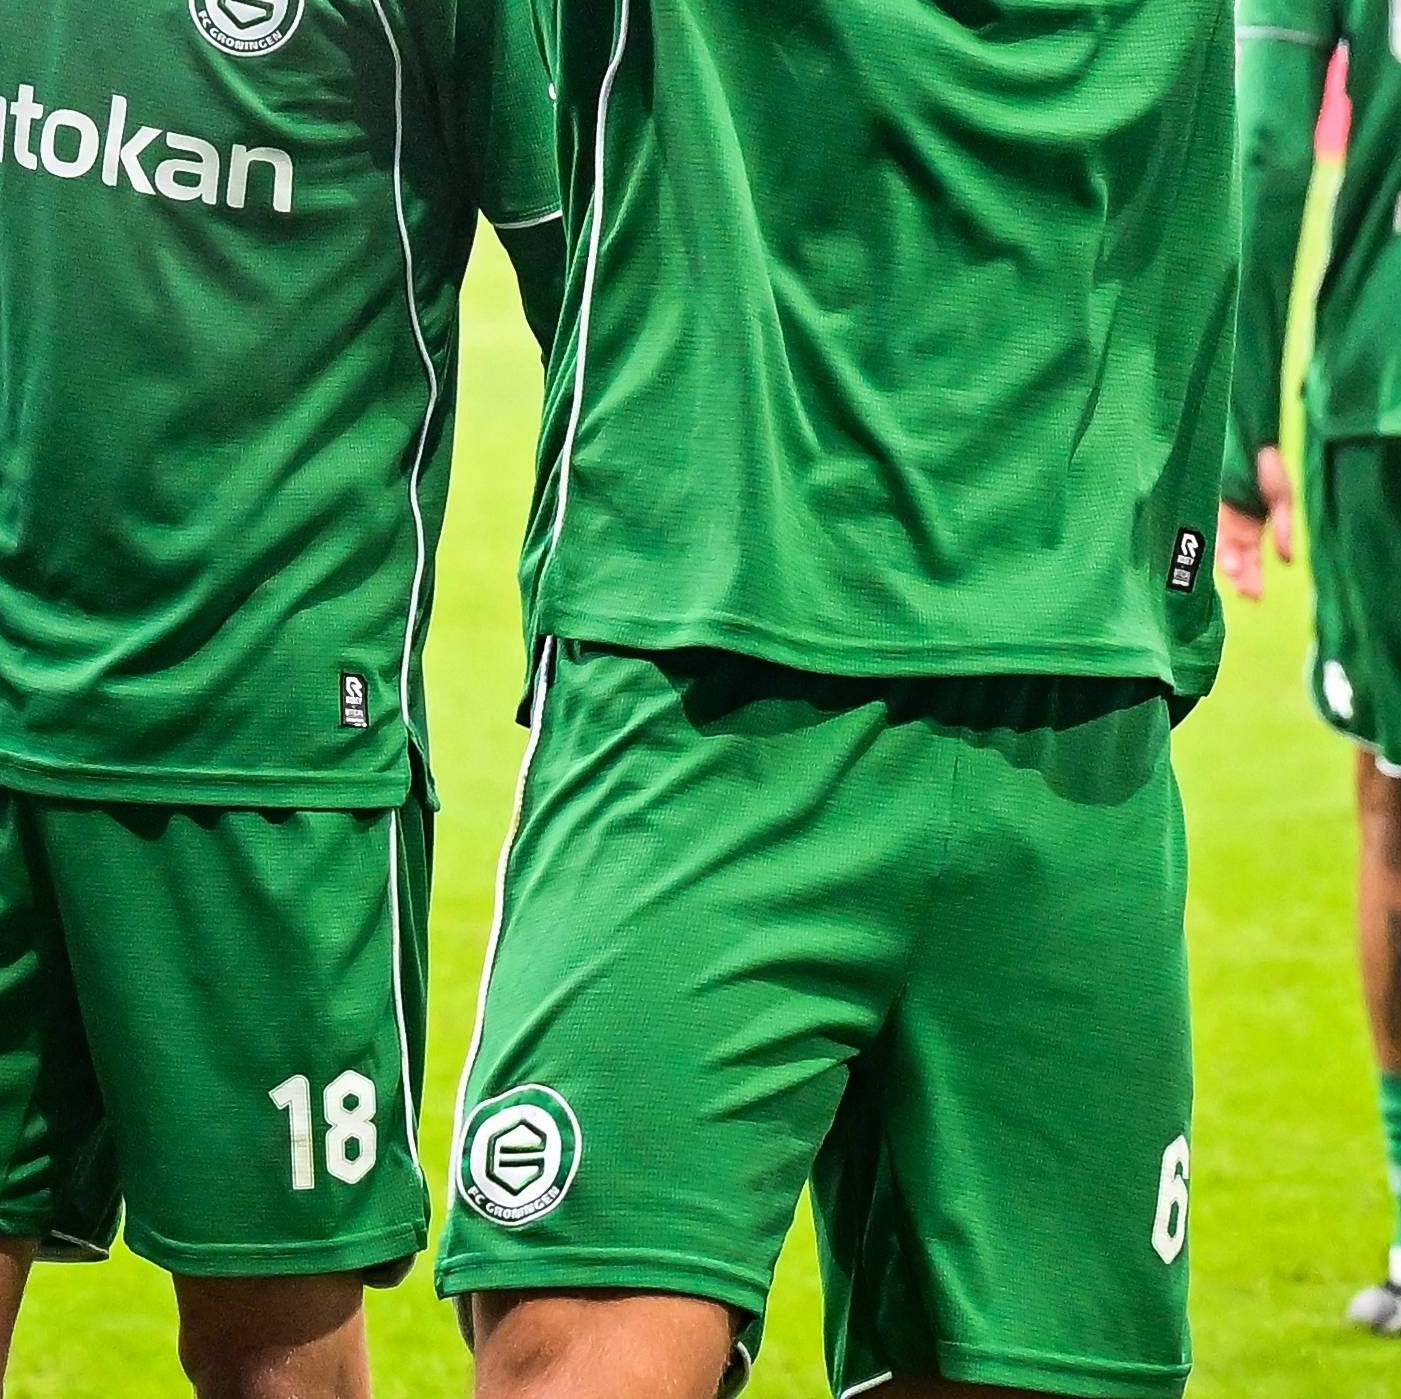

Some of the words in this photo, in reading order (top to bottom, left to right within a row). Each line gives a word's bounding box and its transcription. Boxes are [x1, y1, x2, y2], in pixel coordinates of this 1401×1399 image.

[198, 10, 212, 29] FC
[209, 30, 282, 50] GRONINGEN
[268, 1070, 377, 1190] 18
[467, 1186, 483, 1205] FC
[485, 1185, 560, 1219] GRONINGEN
[1151, 1135, 1189, 1265] 6
